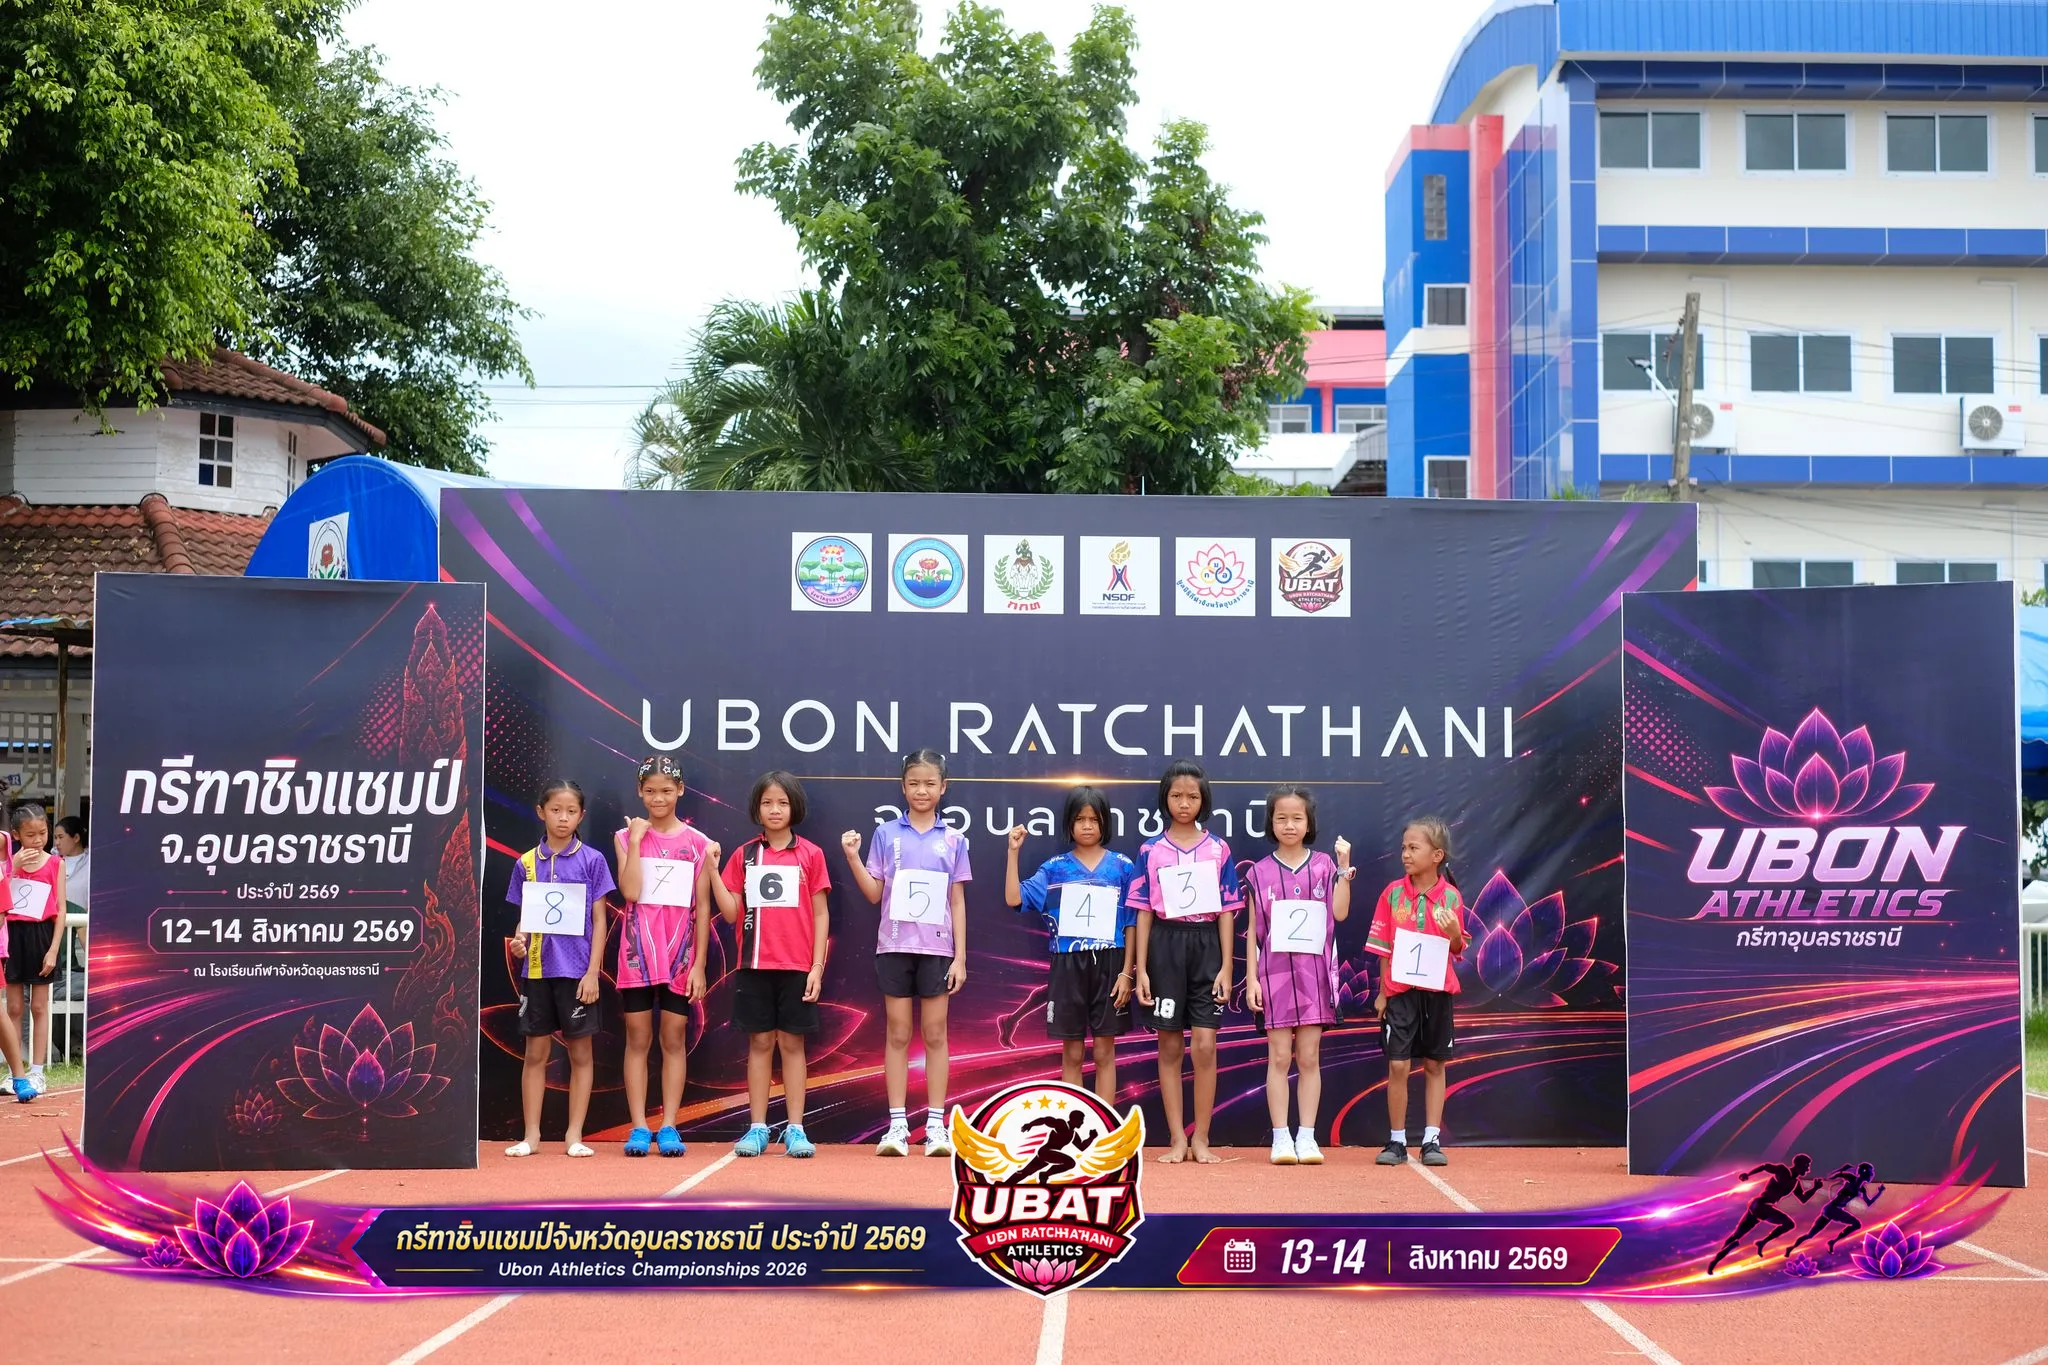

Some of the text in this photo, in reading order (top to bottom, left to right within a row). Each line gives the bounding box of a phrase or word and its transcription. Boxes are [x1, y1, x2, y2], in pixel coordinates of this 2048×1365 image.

[1102, 593, 1136, 602] NSDF
[1283, 578, 1339, 593] UBAT
[642, 699, 1515, 759] UBON RATCHATHANI
[119, 754, 463, 815] กรีฑาชิงแชมป์
[160, 823, 413, 876] จ.อุบลราชธานี
[1687, 826, 1967, 883] UBON
[237, 882, 341, 899] ประจำปี 2569
[652, 865, 676, 896] 7
[759, 872, 784, 901] 6
[1177, 871, 1198, 910] 3
[544, 890, 565, 926] 8
[908, 881, 931, 919] 5
[1074, 892, 1097, 928] 4
[1692, 889, 1956, 919] ATHLETICS
[251, 918, 344, 943] สิงหาคม
[353, 919, 414, 943] 2569
[1287, 908, 1313, 942] 2
[1736, 925, 1903, 953] กรีฑาอุบลราชธานี
[209, 962, 380, 980] โรงเรียนกีฬาจังหวัดอุบลราชธานี
[1405, 942, 1429, 977] 1
[1153, 996, 1176, 1019] 18
